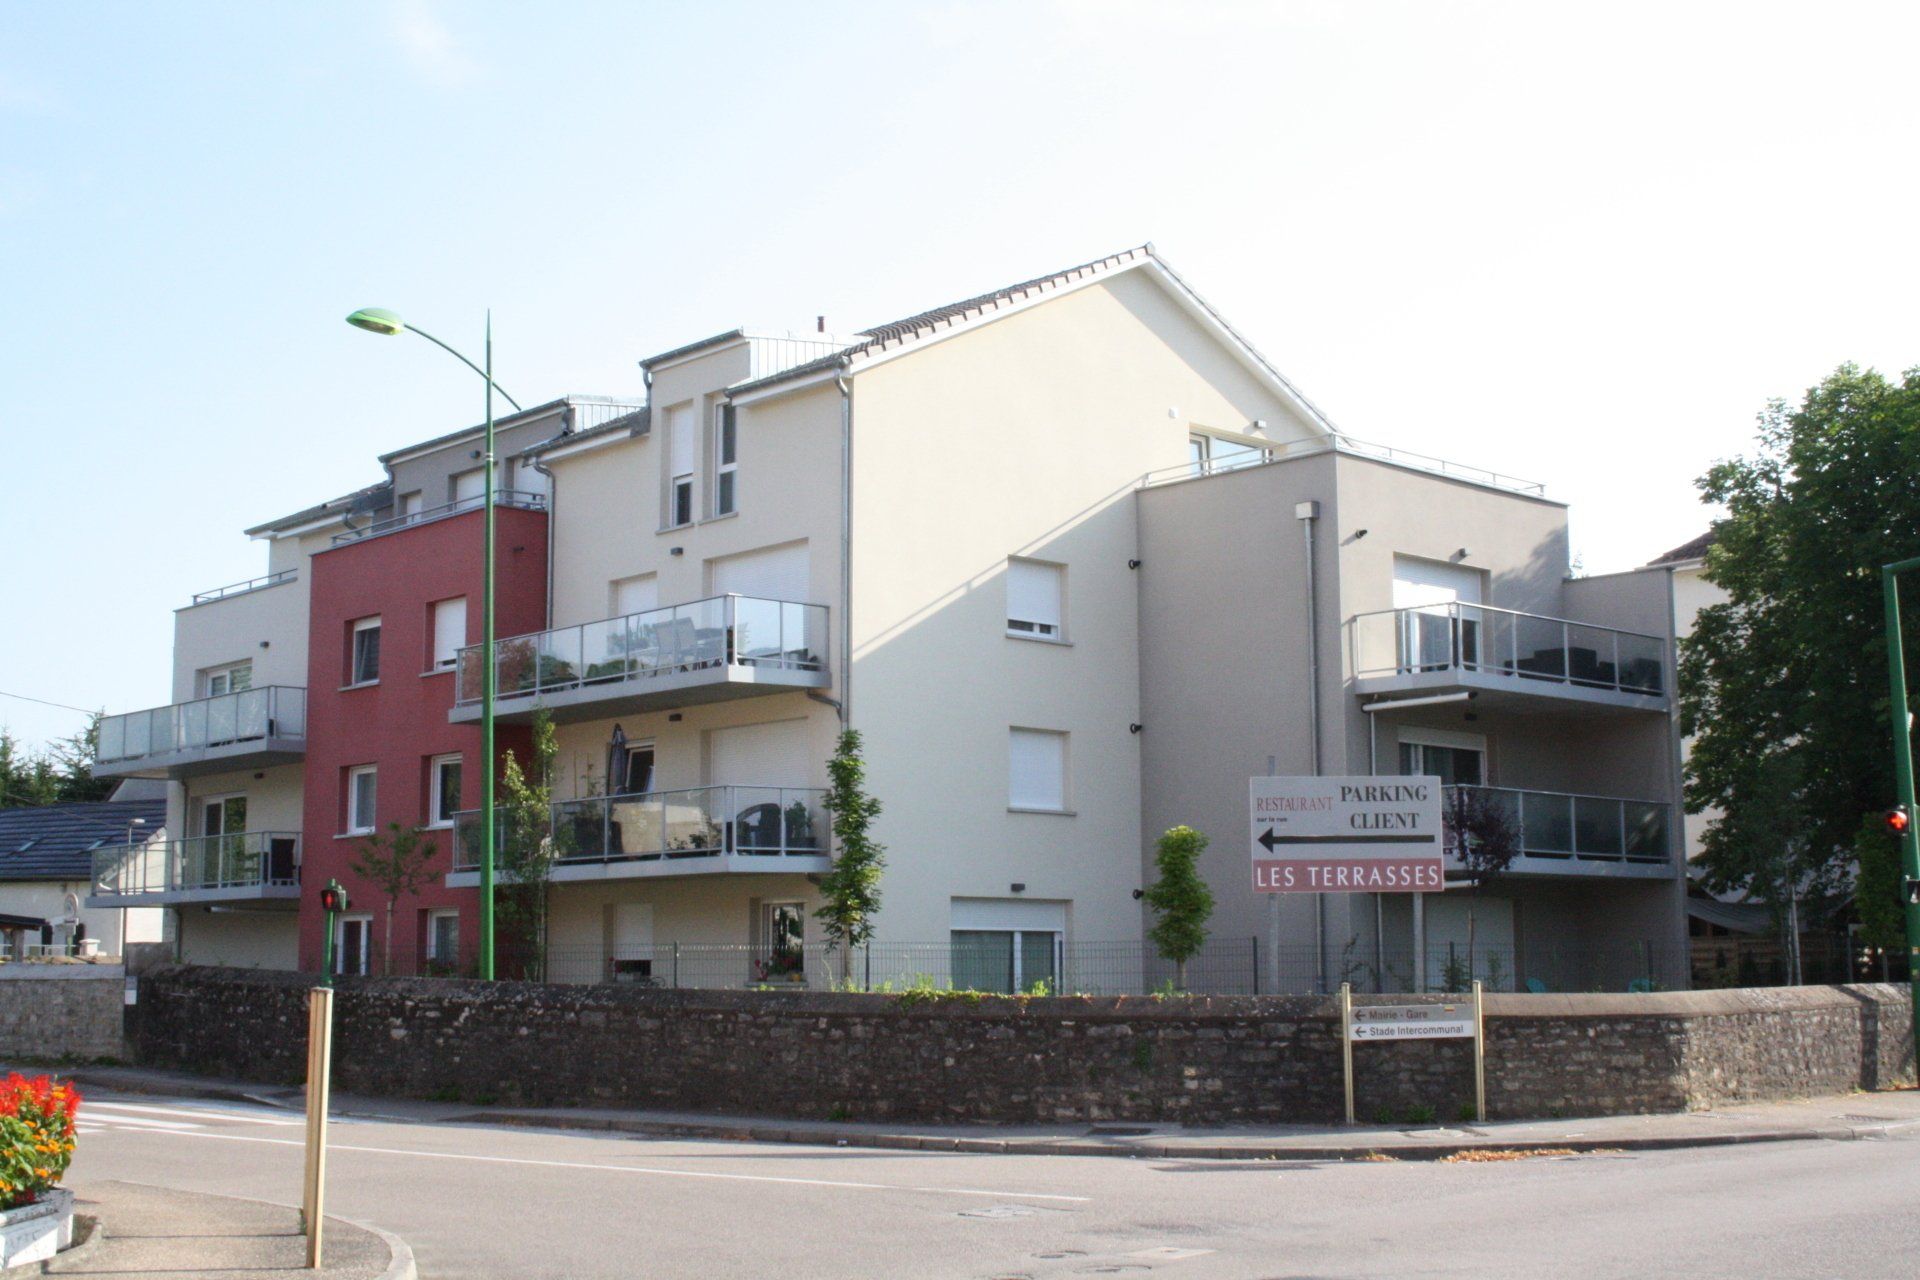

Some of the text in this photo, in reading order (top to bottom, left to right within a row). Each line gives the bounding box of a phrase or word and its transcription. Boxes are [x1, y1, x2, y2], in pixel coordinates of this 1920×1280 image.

[1340, 785, 1428, 802] PARKING
[1256, 797, 1334, 812] RESTAURANT
[1350, 812, 1420, 829] CLIENT
[1257, 865, 1439, 887] LES TERRASSES
[1369, 1010, 1398, 1020] Mairie
[1406, 1009, 1429, 1019] Gare
[1369, 1024, 1465, 1036] Stade Intercommunal
